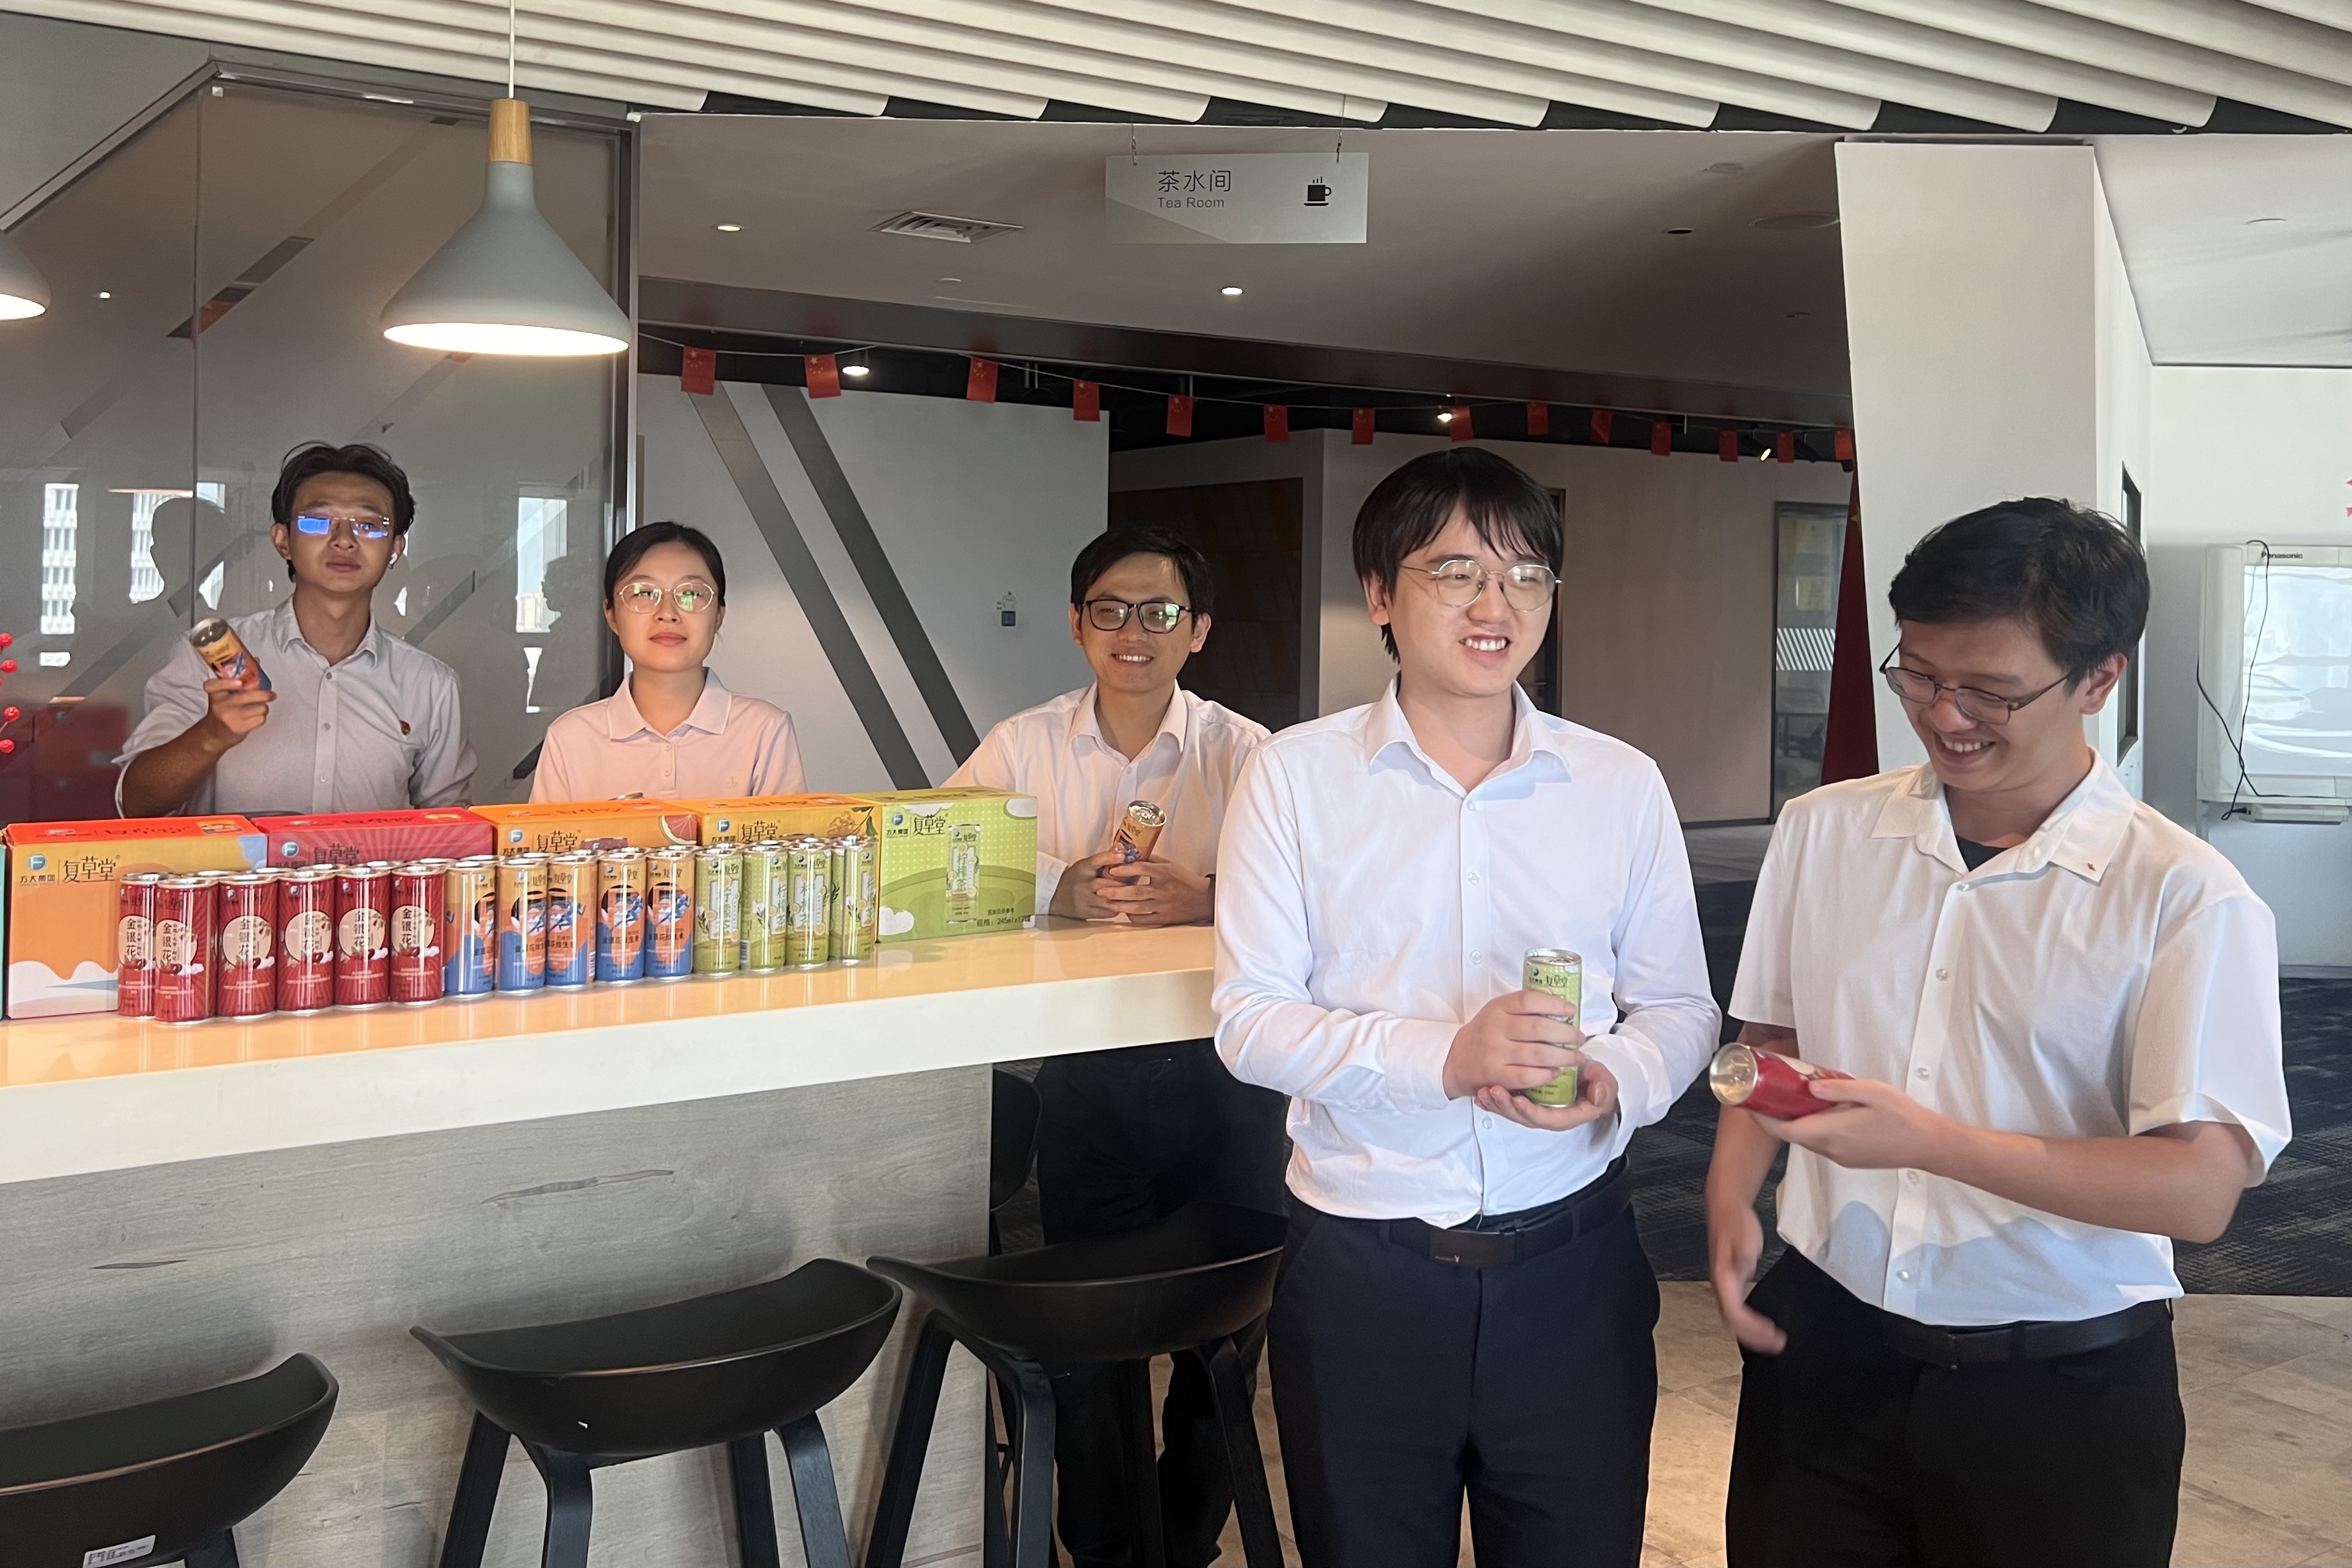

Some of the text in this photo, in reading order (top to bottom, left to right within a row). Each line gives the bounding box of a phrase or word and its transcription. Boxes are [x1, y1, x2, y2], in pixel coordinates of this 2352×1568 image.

[1157, 169, 1231, 192] 茶水间
[1157, 197, 1225, 208] Tea Room
[740, 820, 777, 843] 复草堂
[913, 814, 946, 836] 复草堂
[537, 830, 578, 854] 复草堂
[62, 856, 116, 883] 复草堂
[401, 907, 412, 944] 金银花
[126, 919, 137, 957] 金银花
[162, 922, 172, 961] 金银花
